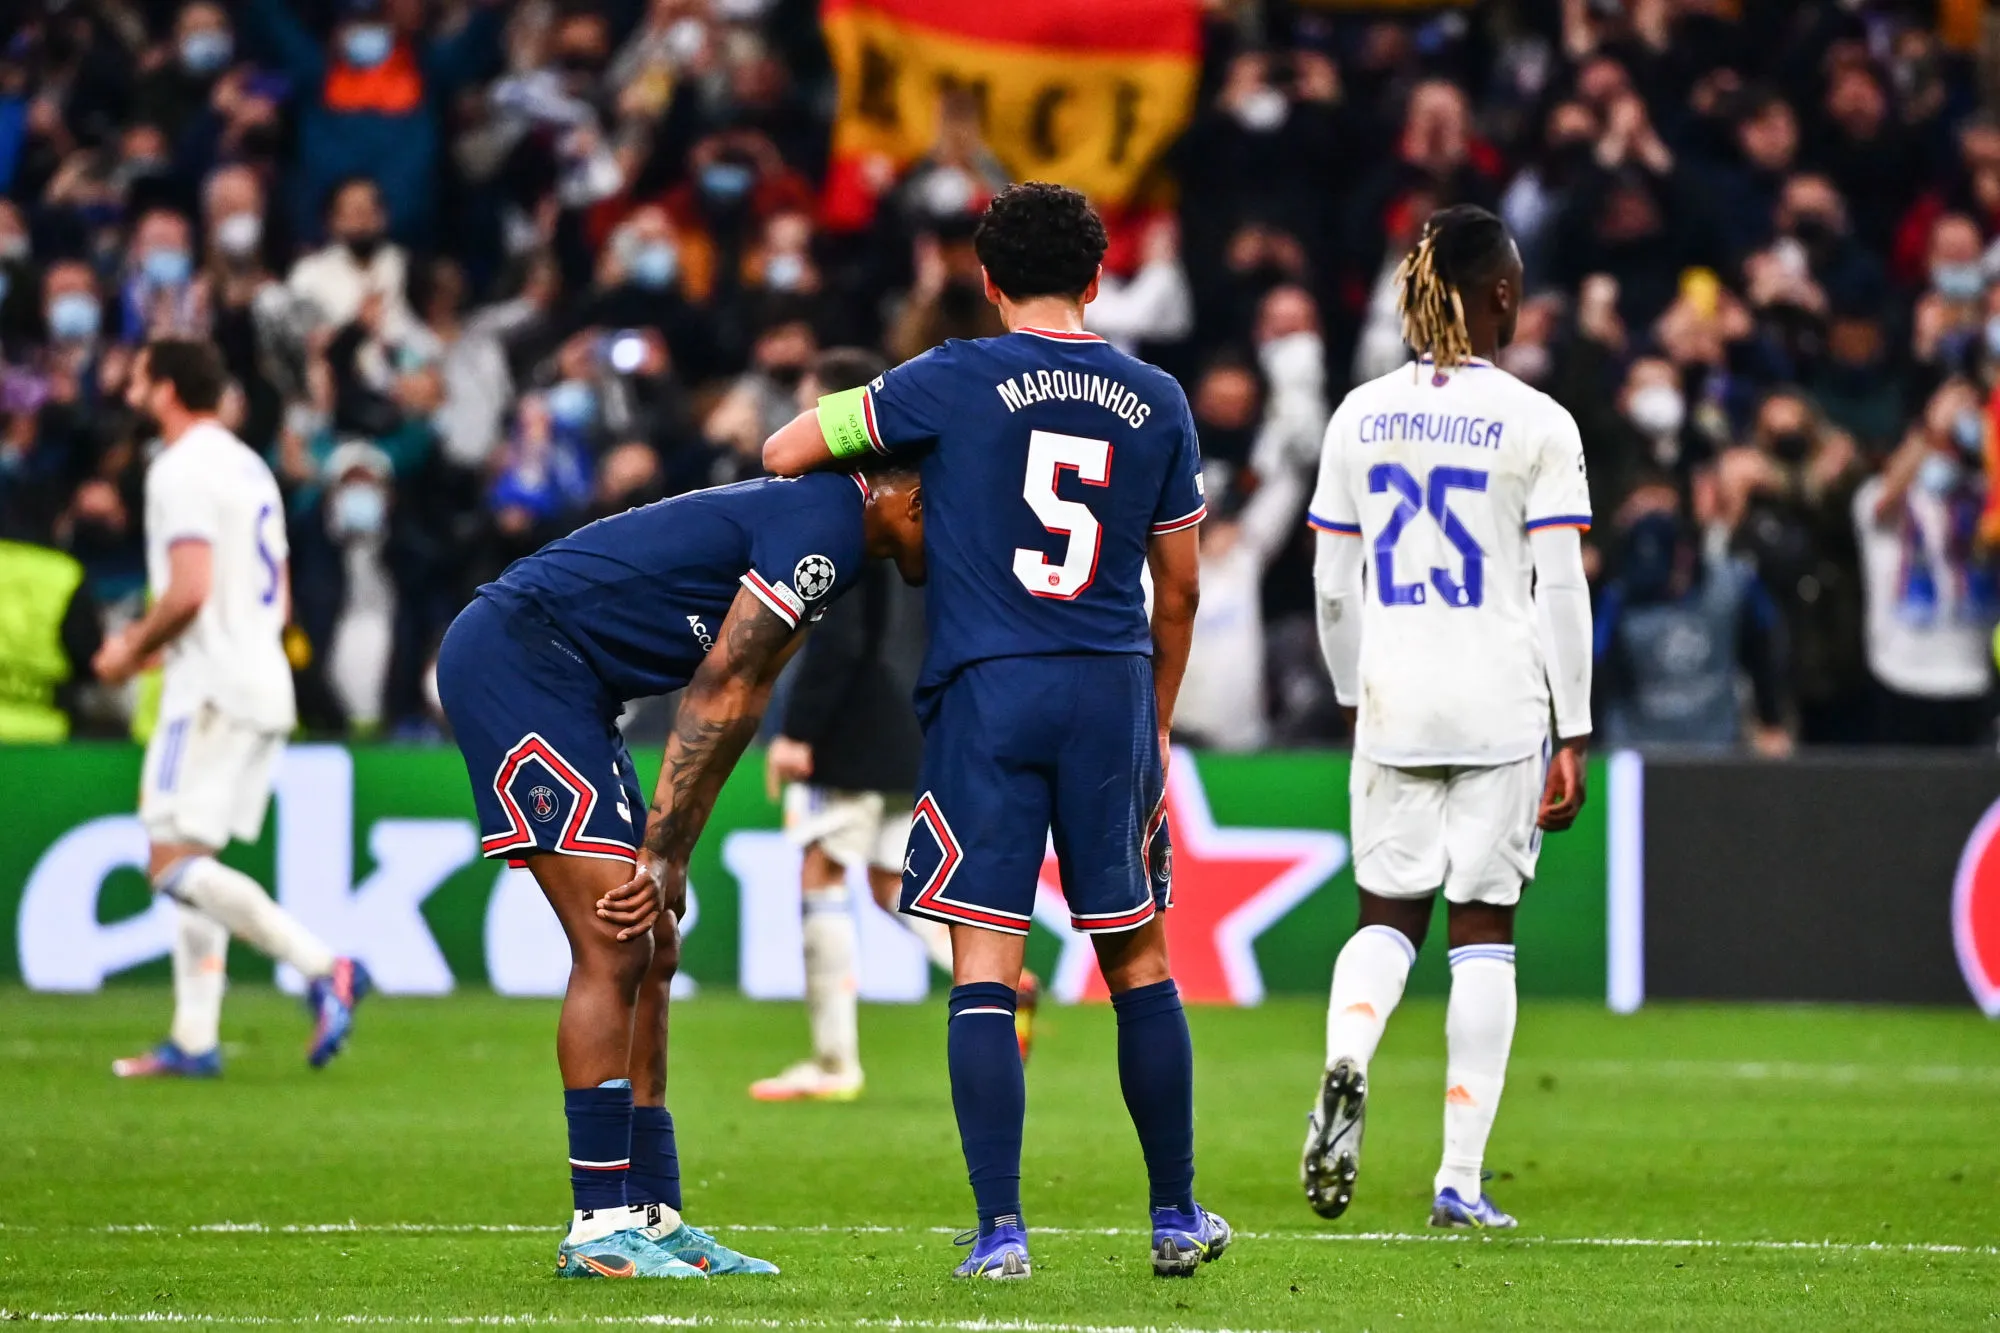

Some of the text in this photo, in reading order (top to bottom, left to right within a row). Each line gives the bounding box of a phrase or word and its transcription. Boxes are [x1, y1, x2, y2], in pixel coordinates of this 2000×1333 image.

[996, 369, 1151, 429] MARQUINHOS
[1360, 413, 1504, 450] CAMAVINGA
[1012, 429, 1114, 601] 5
[1368, 463, 1489, 608] 25
[529, 787, 552, 798] PARIS
